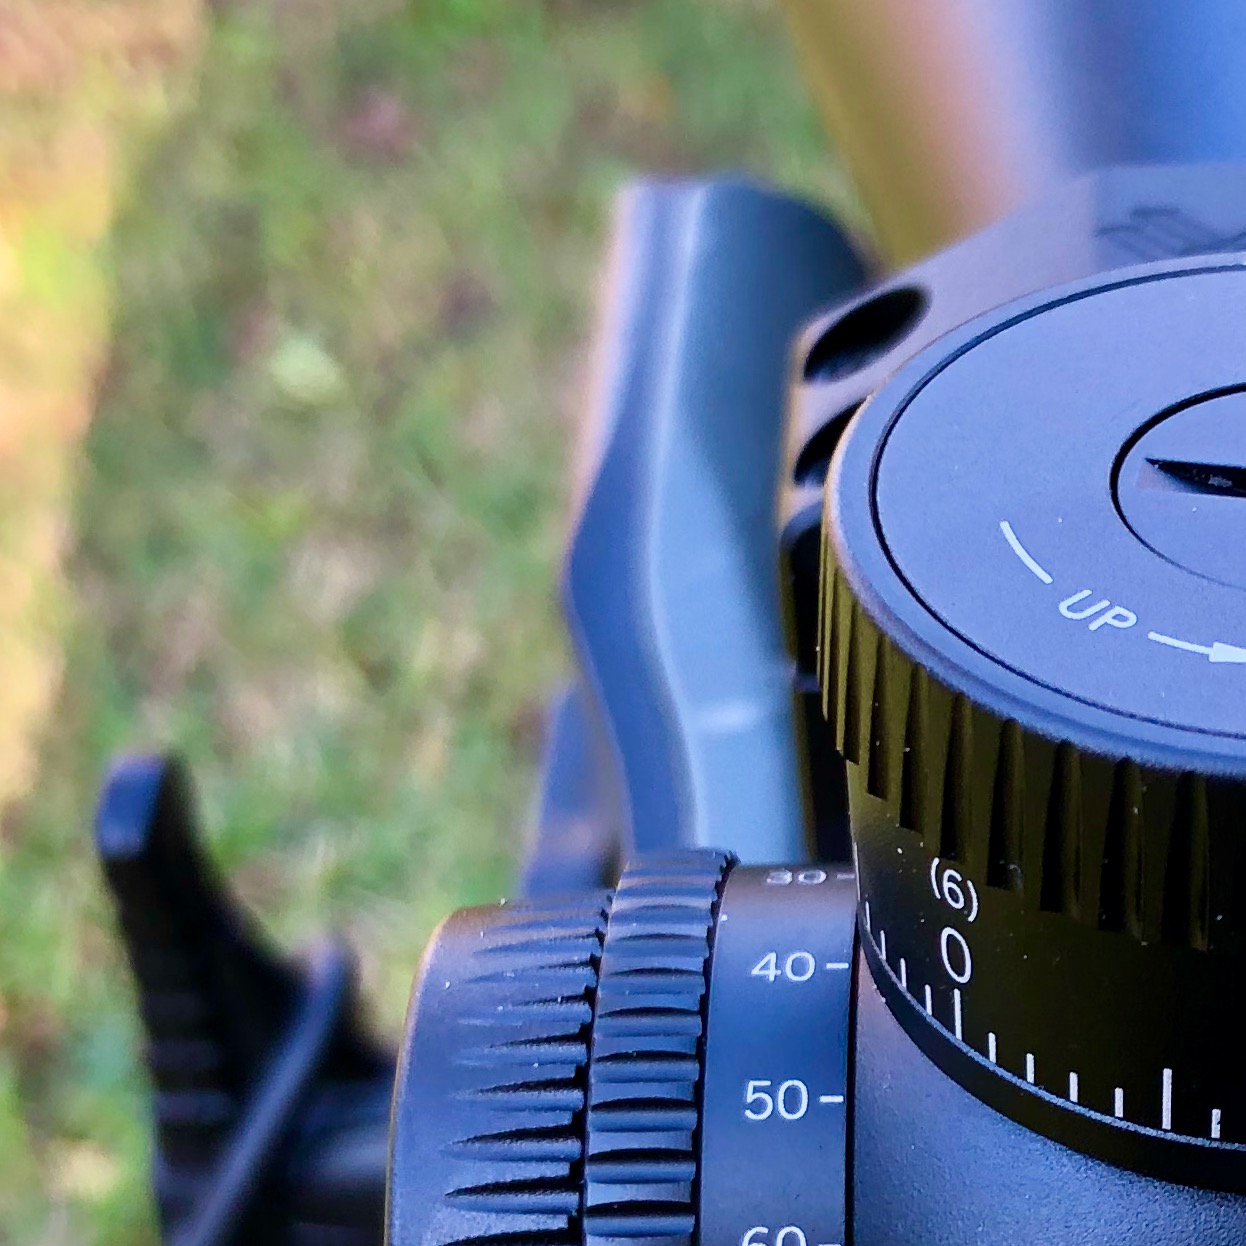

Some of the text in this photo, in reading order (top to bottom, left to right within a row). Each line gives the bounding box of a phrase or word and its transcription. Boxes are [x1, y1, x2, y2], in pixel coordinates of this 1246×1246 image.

[1058, 589, 1138, 631] UP
[930, 857, 979, 922] (6)
[751, 952, 816, 982] 40
[940, 926, 972, 984] 0
[744, 1079, 809, 1120] 50
